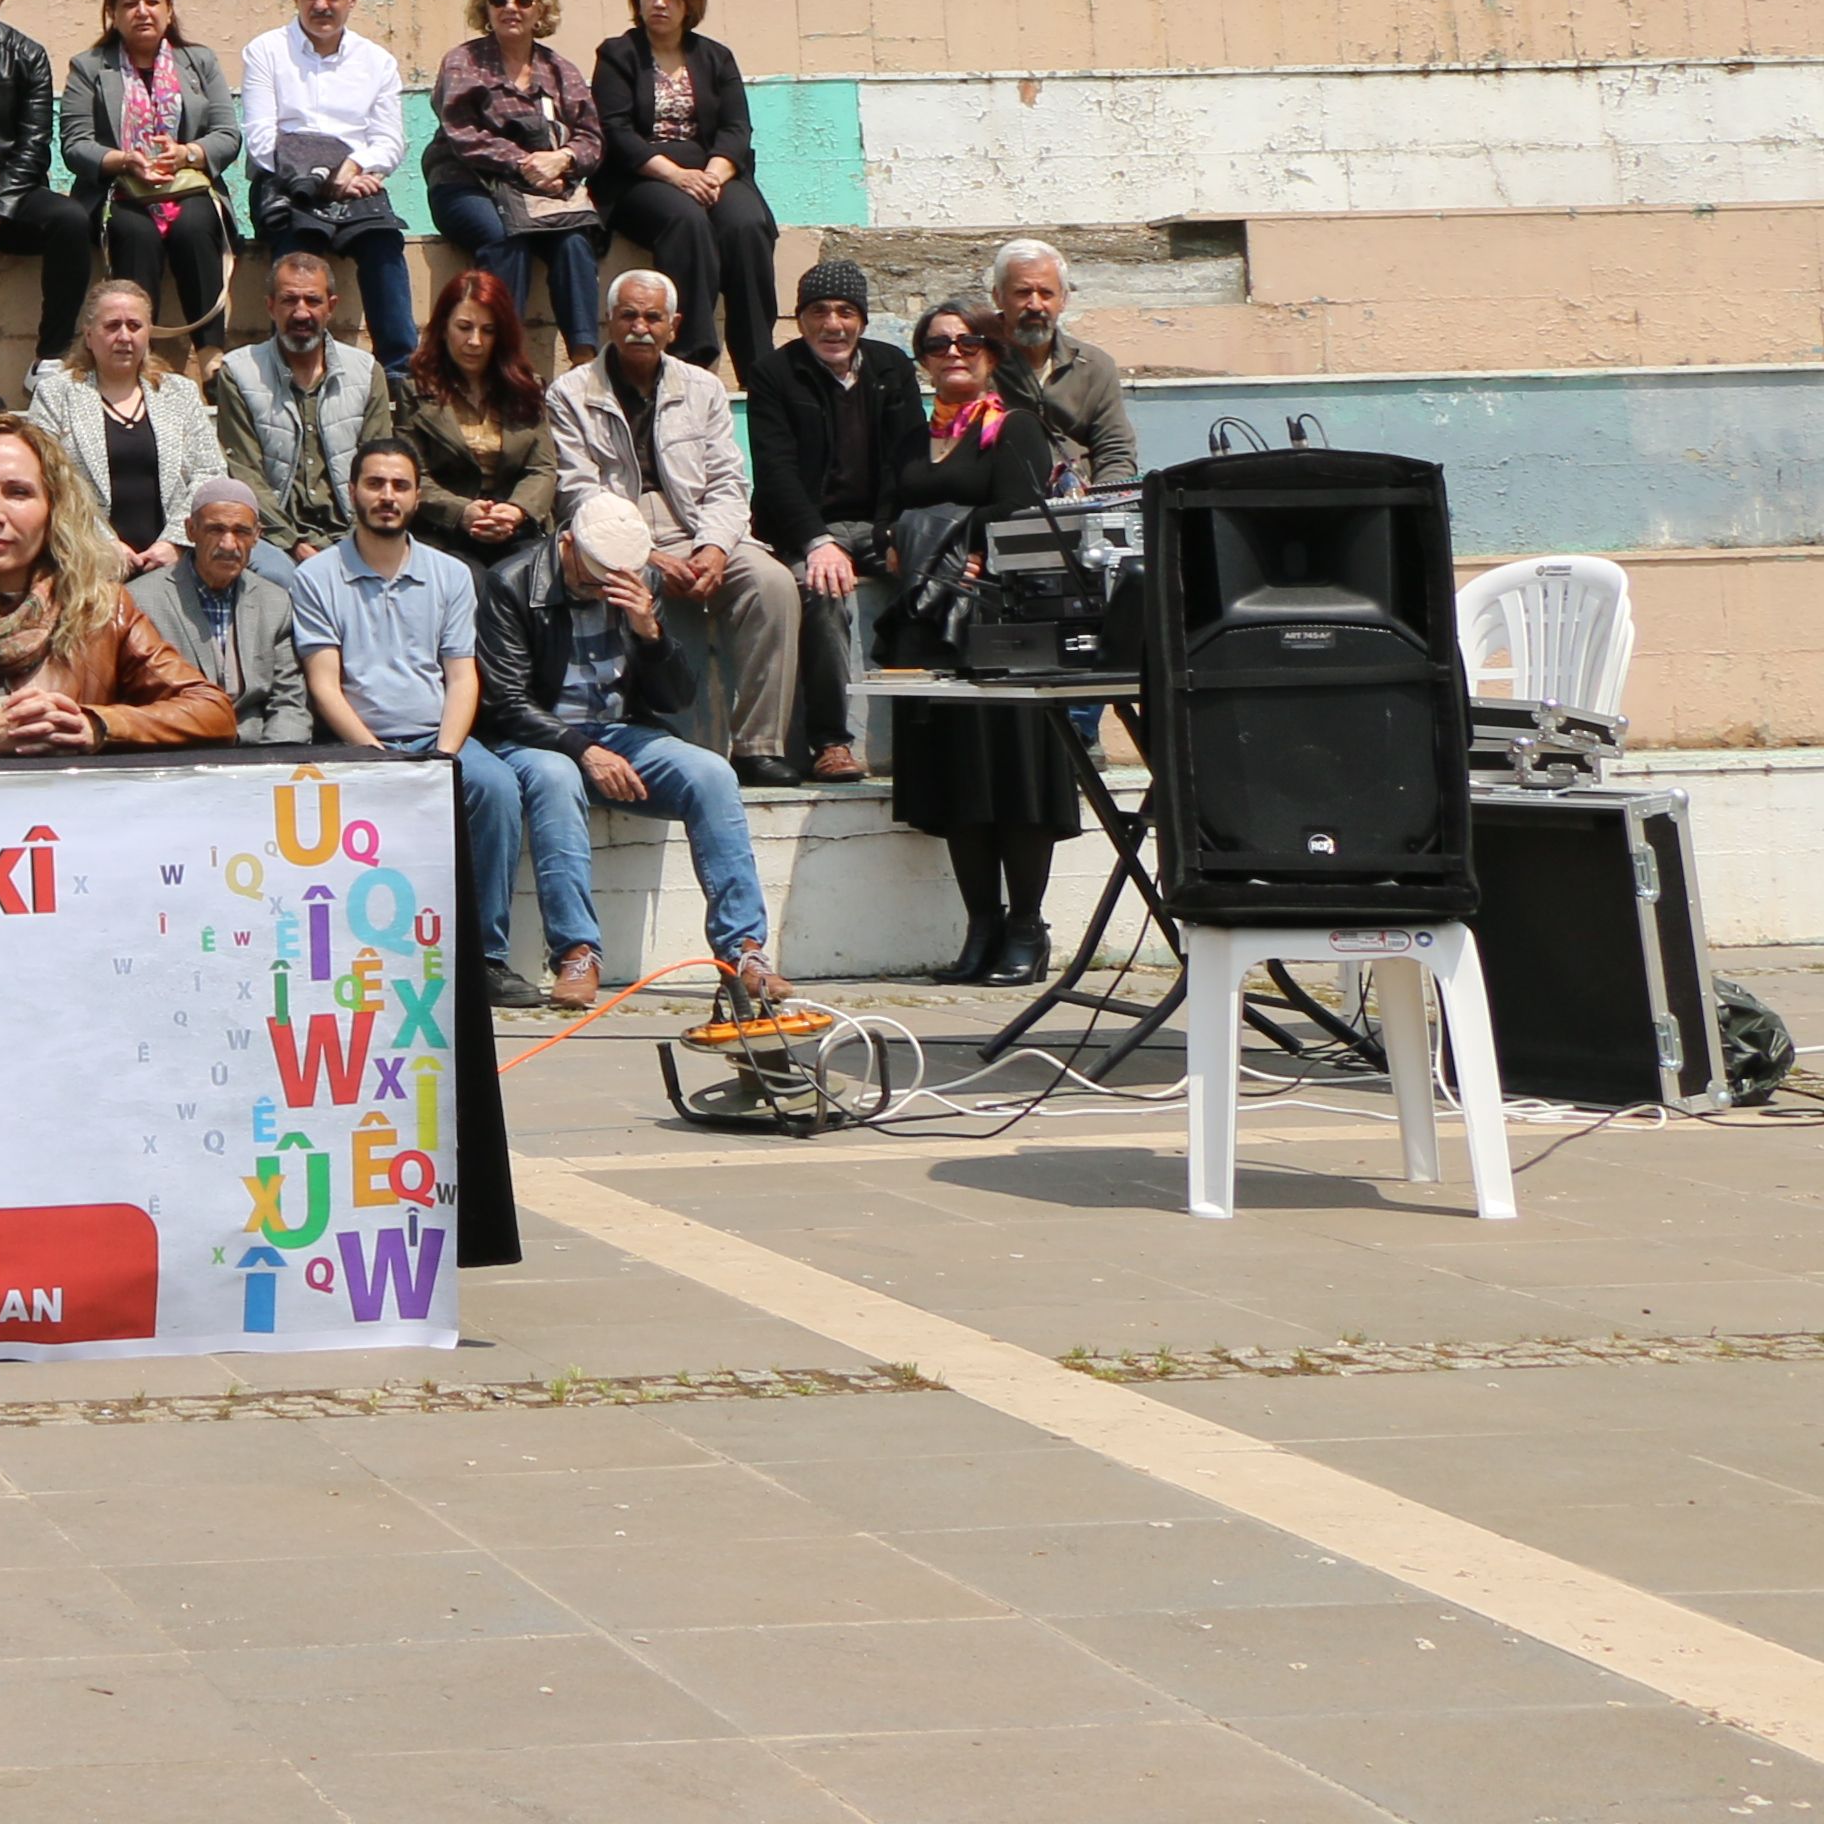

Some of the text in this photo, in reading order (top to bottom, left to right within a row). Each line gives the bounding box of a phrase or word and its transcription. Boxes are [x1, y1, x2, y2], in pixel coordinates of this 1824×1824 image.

[342, 820, 380, 867] Q
[160, 864, 184, 885] W
[225, 853, 264, 901] Q
[346, 867, 417, 957] Q
[234, 931, 251, 946] W
[334, 974, 365, 1012] Q
[390, 979, 449, 1049] X
[266, 1010, 376, 1108] W
[373, 1057, 408, 1100] X
[388, 1150, 436, 1208] Q
[436, 1182, 457, 1205] W
[241, 1175, 287, 1232] X
[212, 1247, 225, 1264] X
[305, 1257, 334, 1294] Q
[336, 1228, 446, 1322] W
